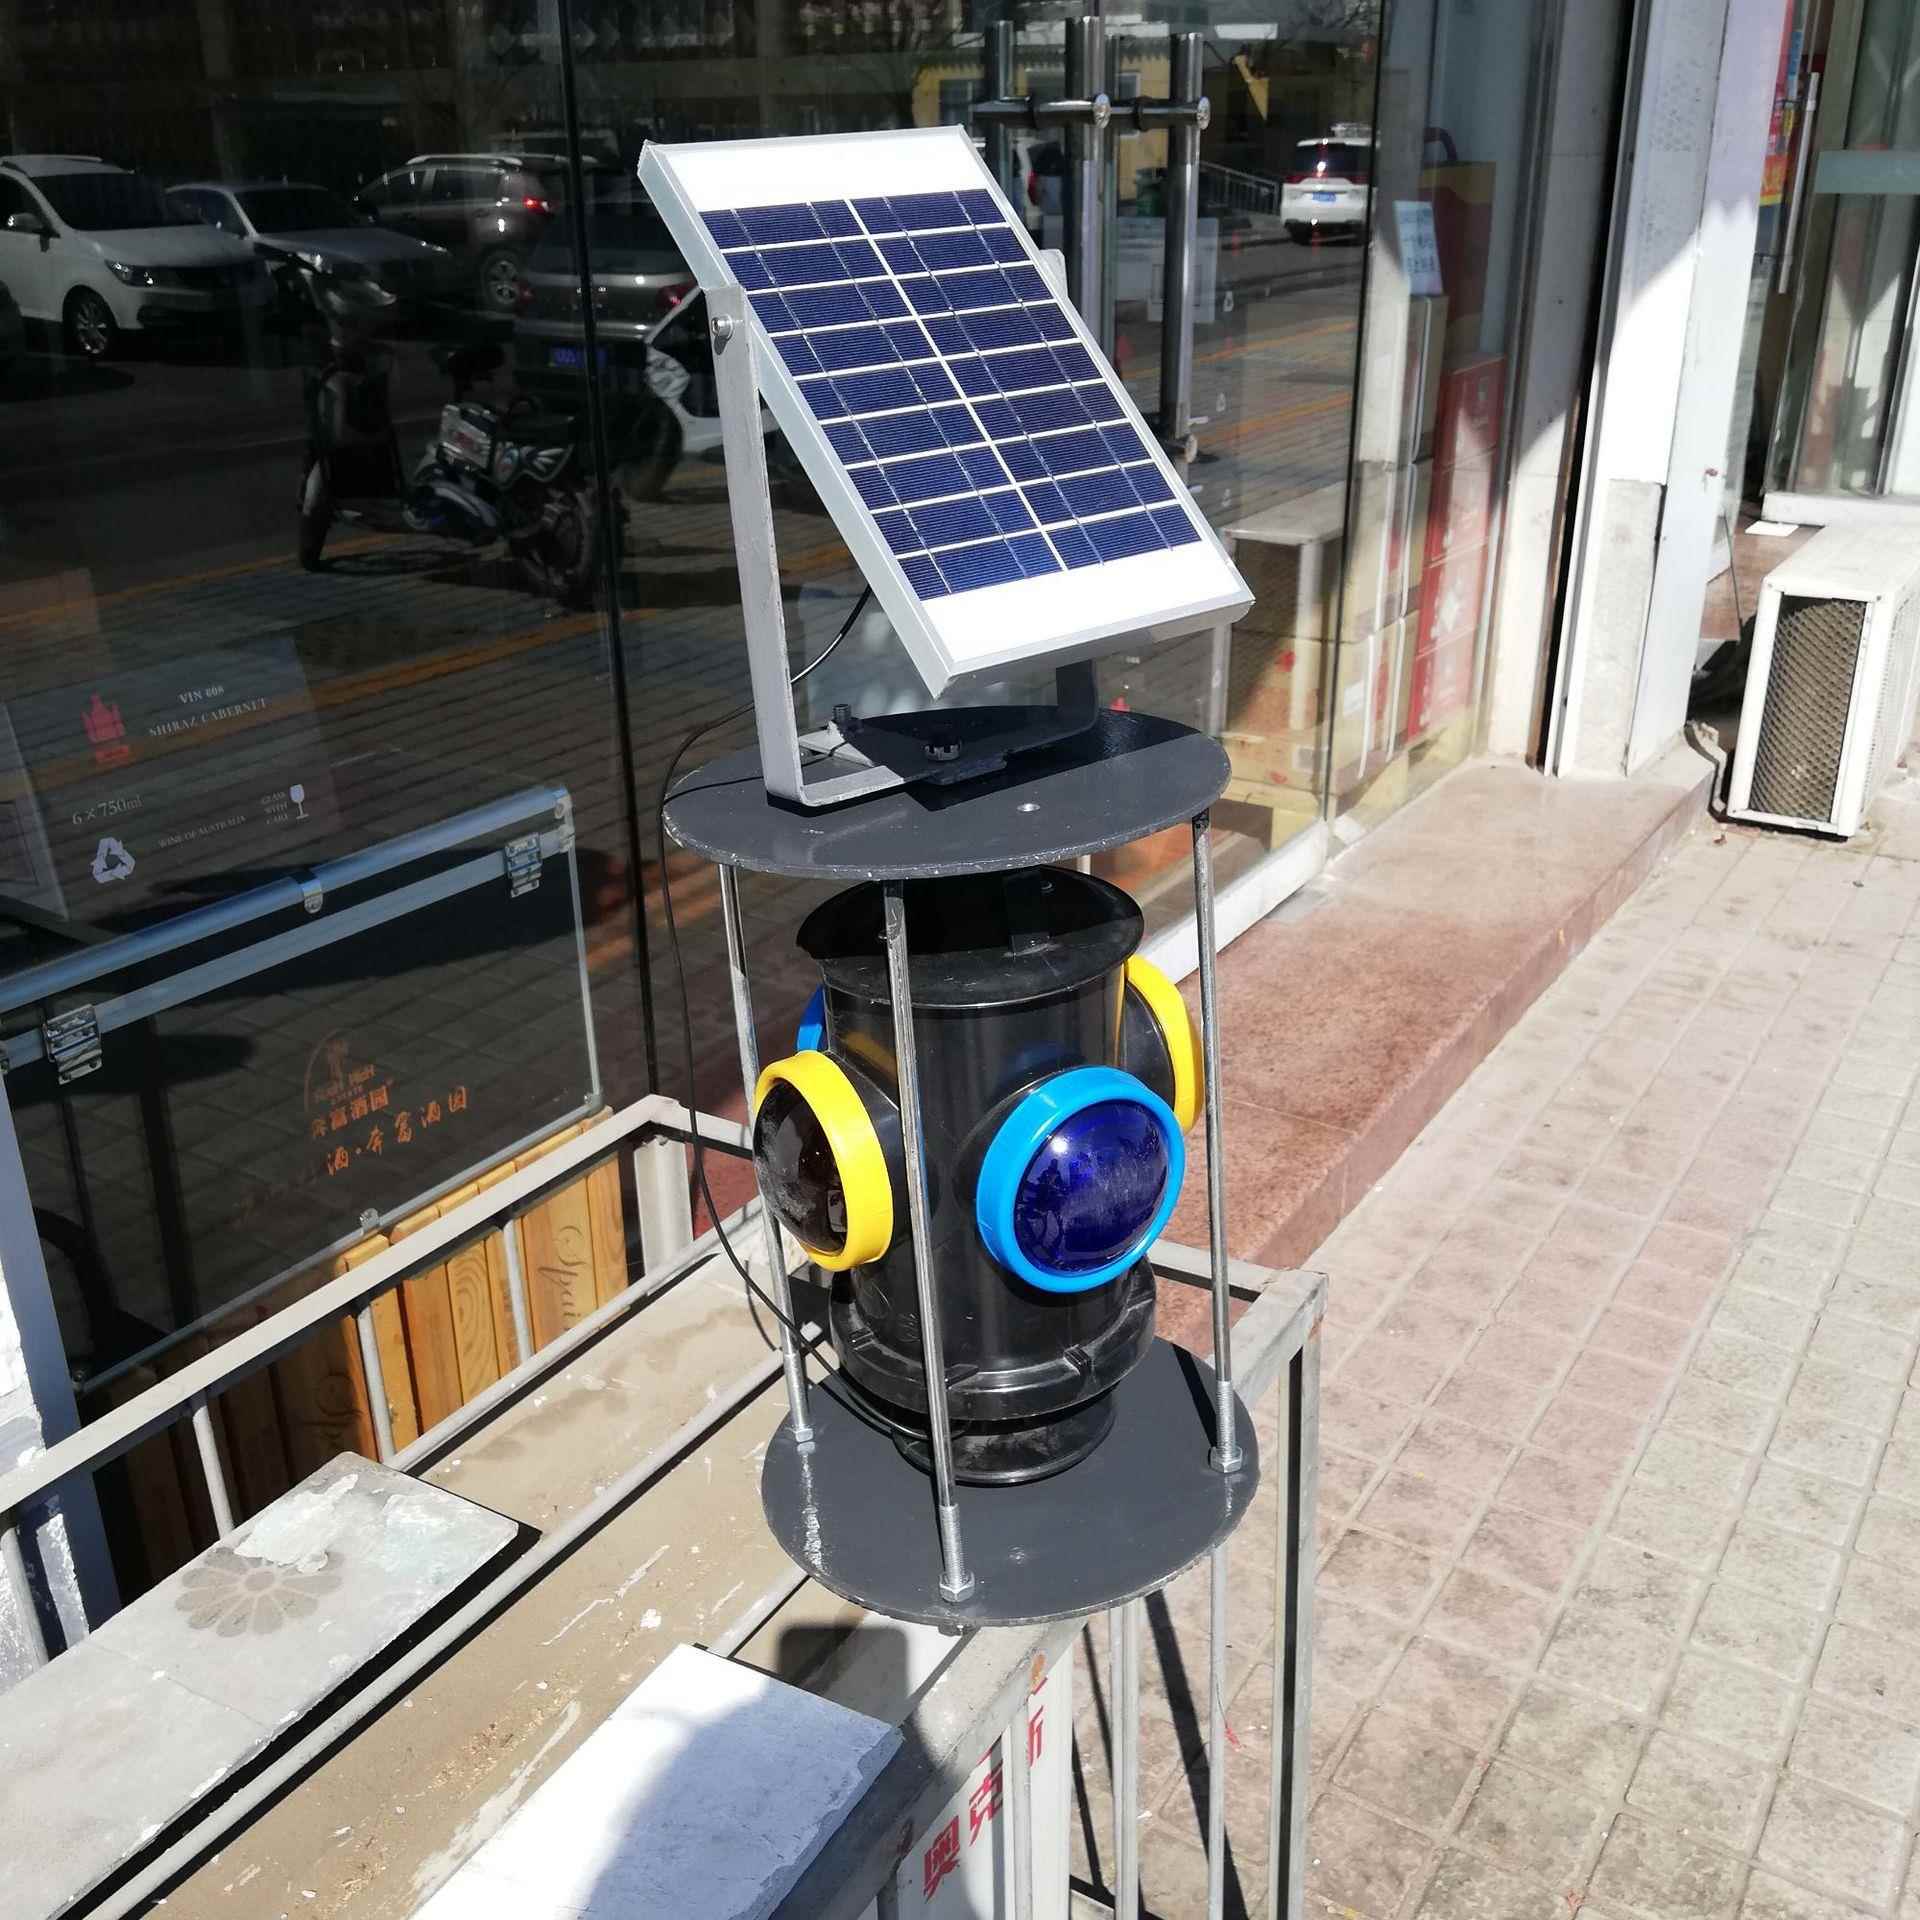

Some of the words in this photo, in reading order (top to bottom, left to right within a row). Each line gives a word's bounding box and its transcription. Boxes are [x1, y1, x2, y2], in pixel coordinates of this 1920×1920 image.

[179, 690, 203, 703] VIN
[148, 714, 198, 737] SHIRAZ
[201, 697, 266, 724] CABERNET
[72, 811, 83, 825] 6
